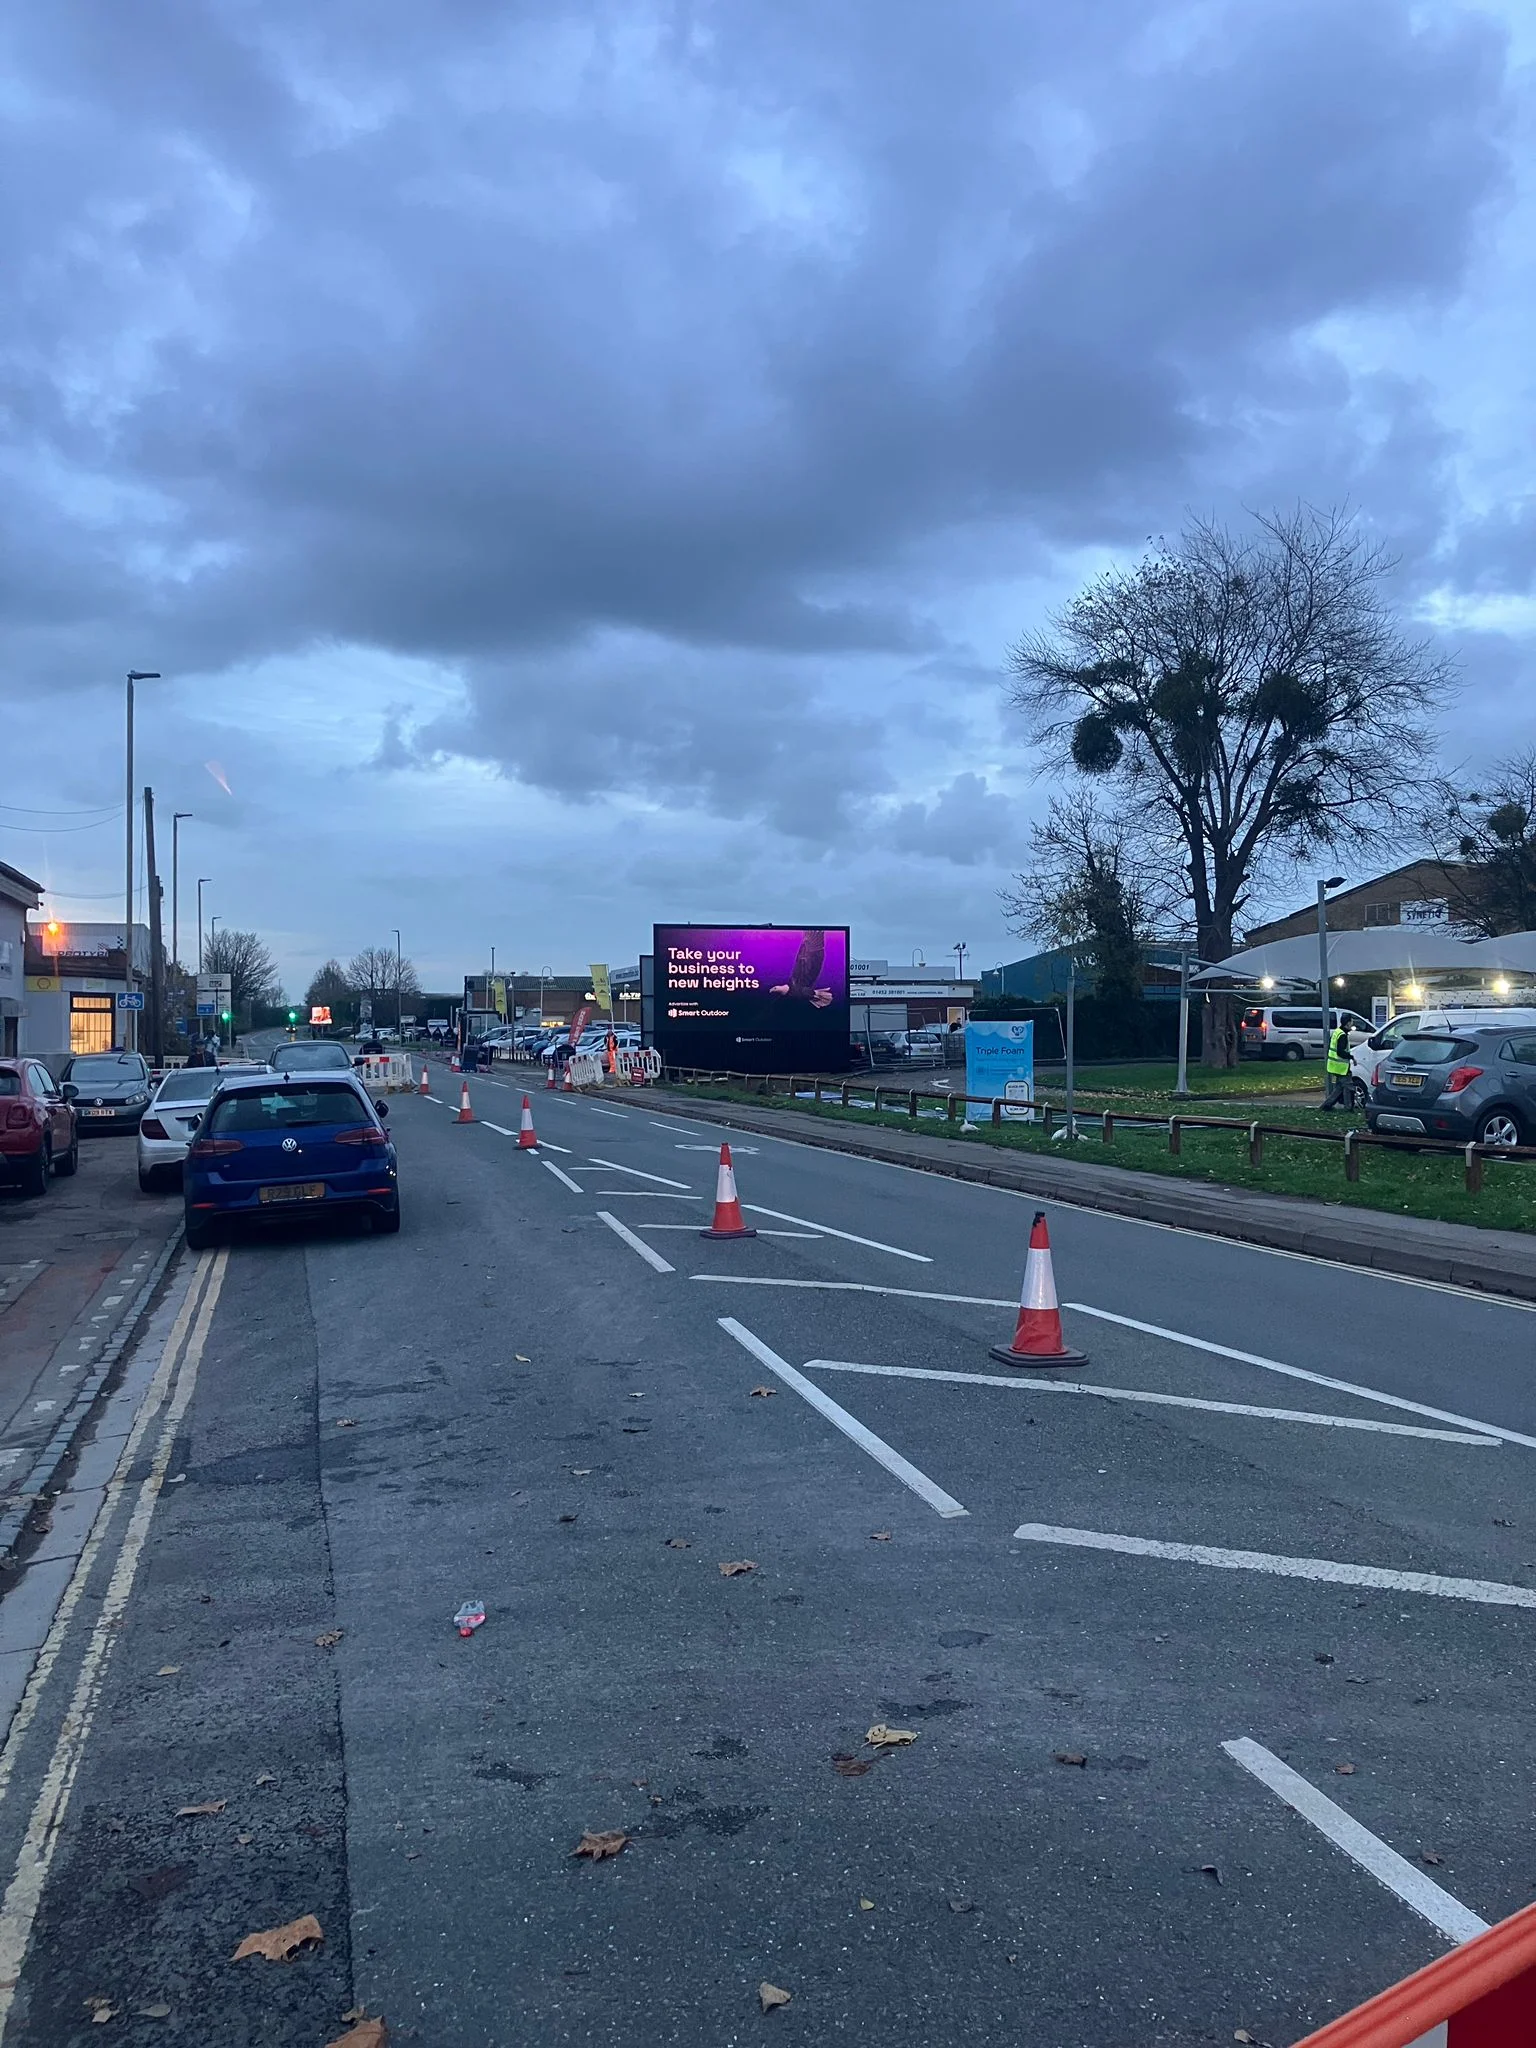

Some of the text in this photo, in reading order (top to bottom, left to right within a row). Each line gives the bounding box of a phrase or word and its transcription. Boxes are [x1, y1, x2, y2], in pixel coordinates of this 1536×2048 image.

[668, 947, 742, 963] Take your
[668, 962, 755, 974] business to
[668, 976, 760, 991] new heights
[976, 1046, 1025, 1056] Triple Foam
